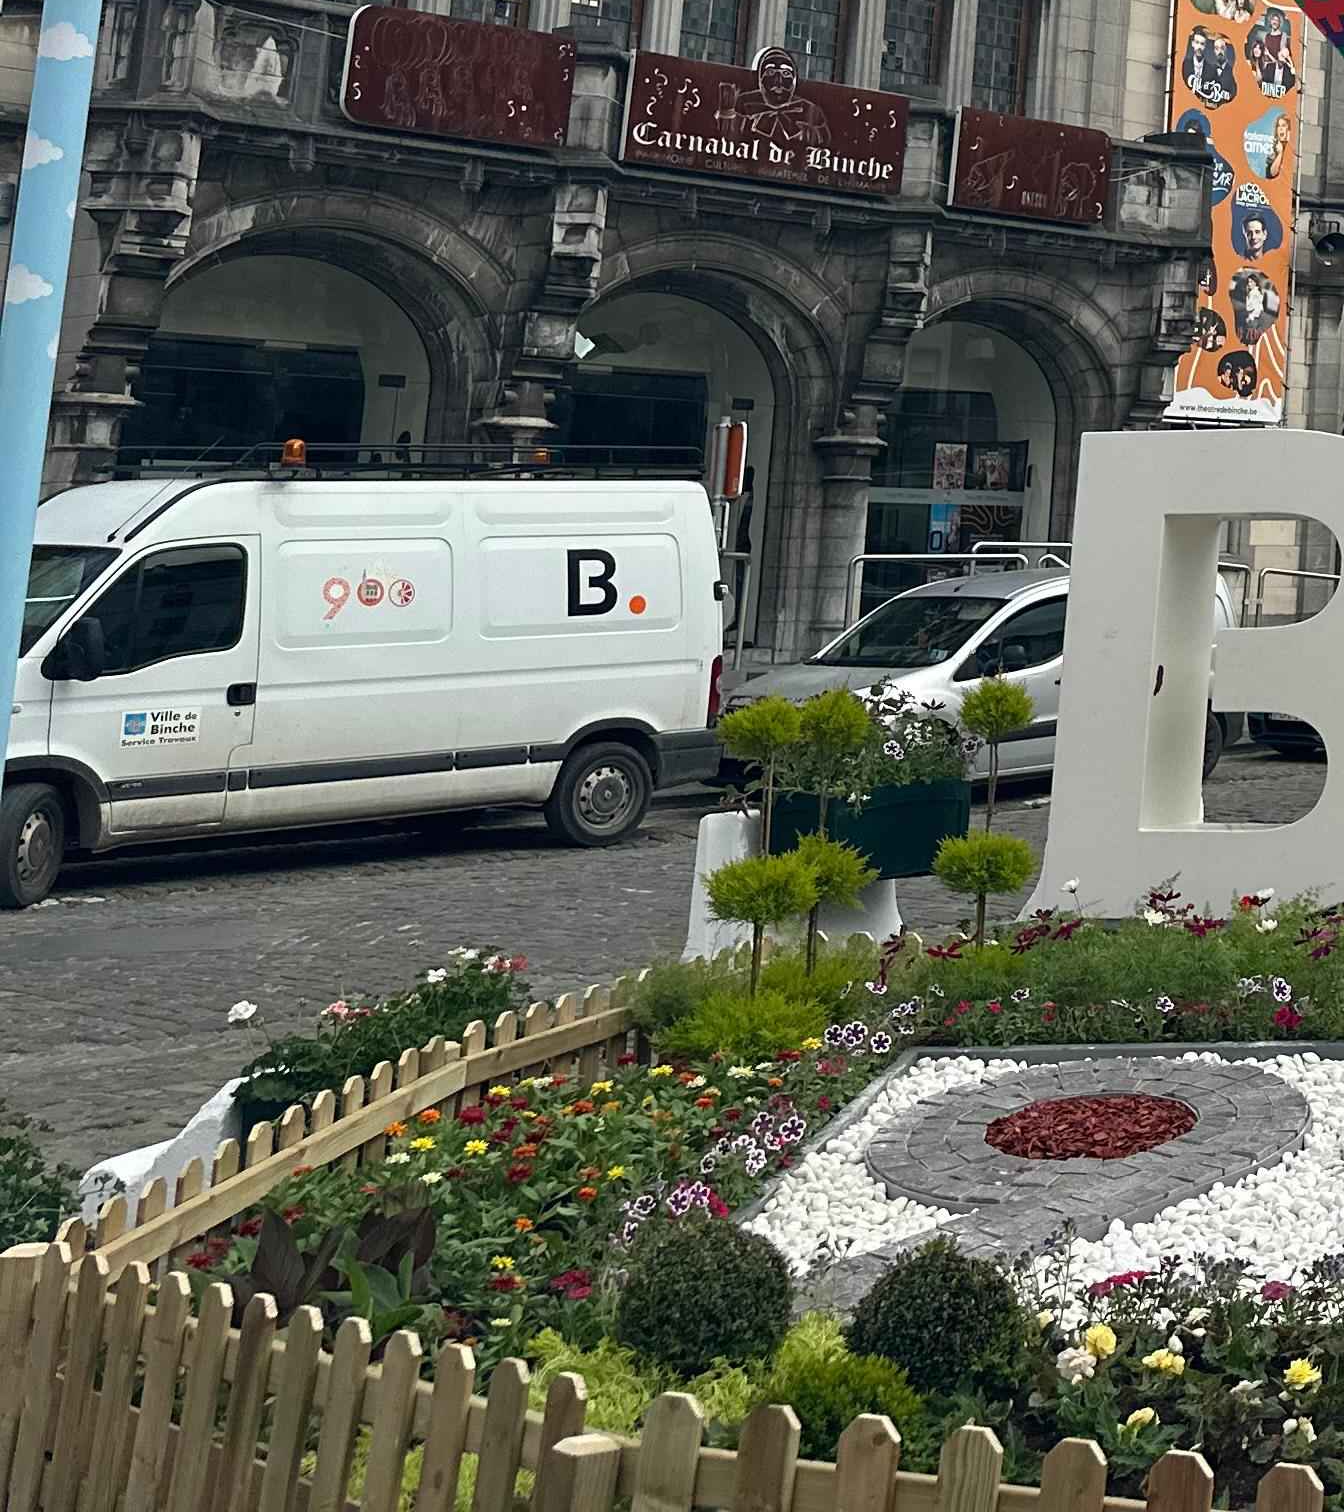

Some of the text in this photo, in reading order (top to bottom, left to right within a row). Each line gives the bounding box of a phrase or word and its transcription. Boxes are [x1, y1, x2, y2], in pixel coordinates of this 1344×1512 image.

[632, 121, 760, 162] Carnaval
[768, 141, 797, 166] de
[806, 146, 895, 181] Binche
[151, 710, 198, 723] Ville de
[150, 722, 196, 735] Binche
[121, 738, 156, 747] Service
